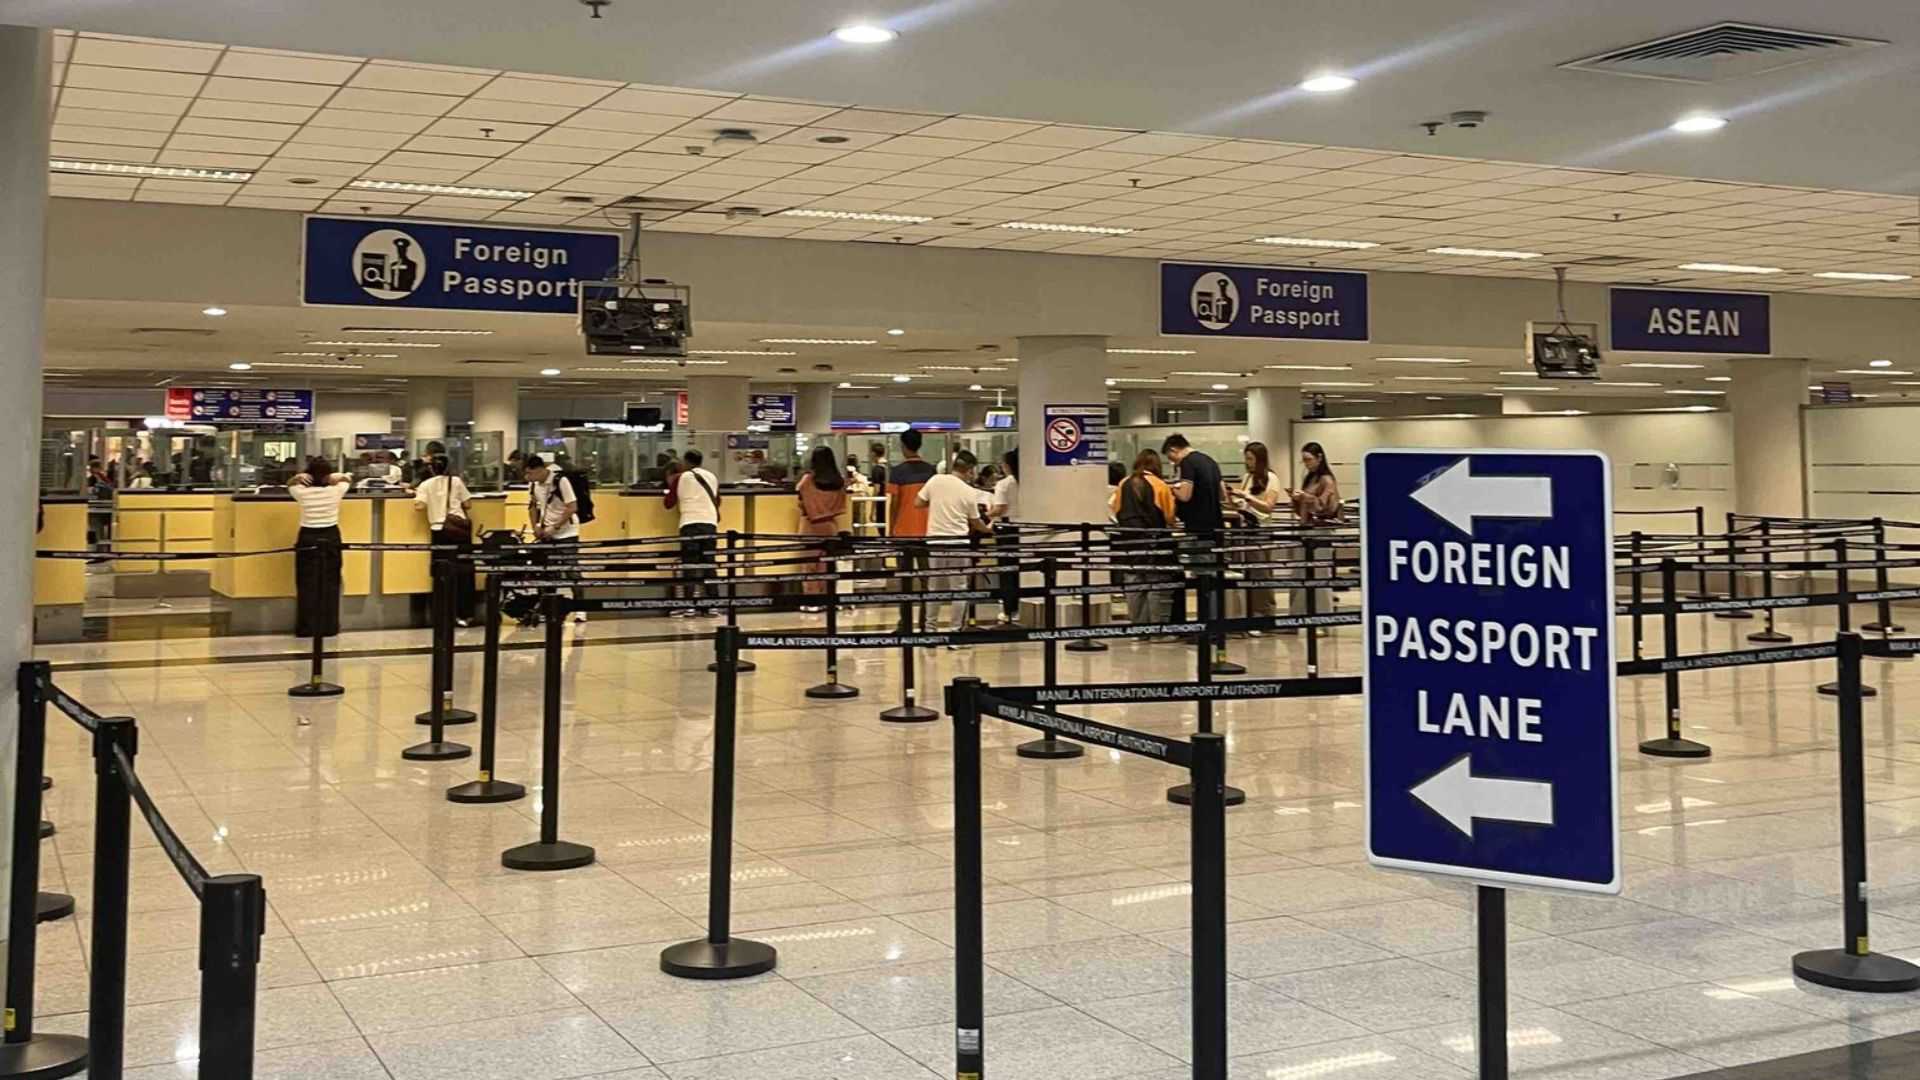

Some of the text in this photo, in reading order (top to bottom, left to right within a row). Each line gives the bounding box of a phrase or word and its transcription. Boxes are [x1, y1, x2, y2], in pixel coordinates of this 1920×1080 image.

[454, 237, 568, 267] Foreign
[442, 271, 578, 301] Passport
[1256, 278, 1333, 303] Foreign
[1250, 305, 1341, 330] Passport
[1647, 307, 1740, 337] ASEAN
[1389, 539, 1570, 589] FOREIGN
[747, 636, 950, 646] MANILA INTERNATIONAL AIRPORT AUTHORITY
[1027, 623, 1207, 640] MANILA INTERNATIONAL AIRPORT AUTHORITY
[1375, 614, 1598, 671] PASSPORT
[1036, 683, 1282, 701] MANILA INTERNATIONAL AIRPORT AUTHORITY
[1417, 689, 1543, 743] LANE
